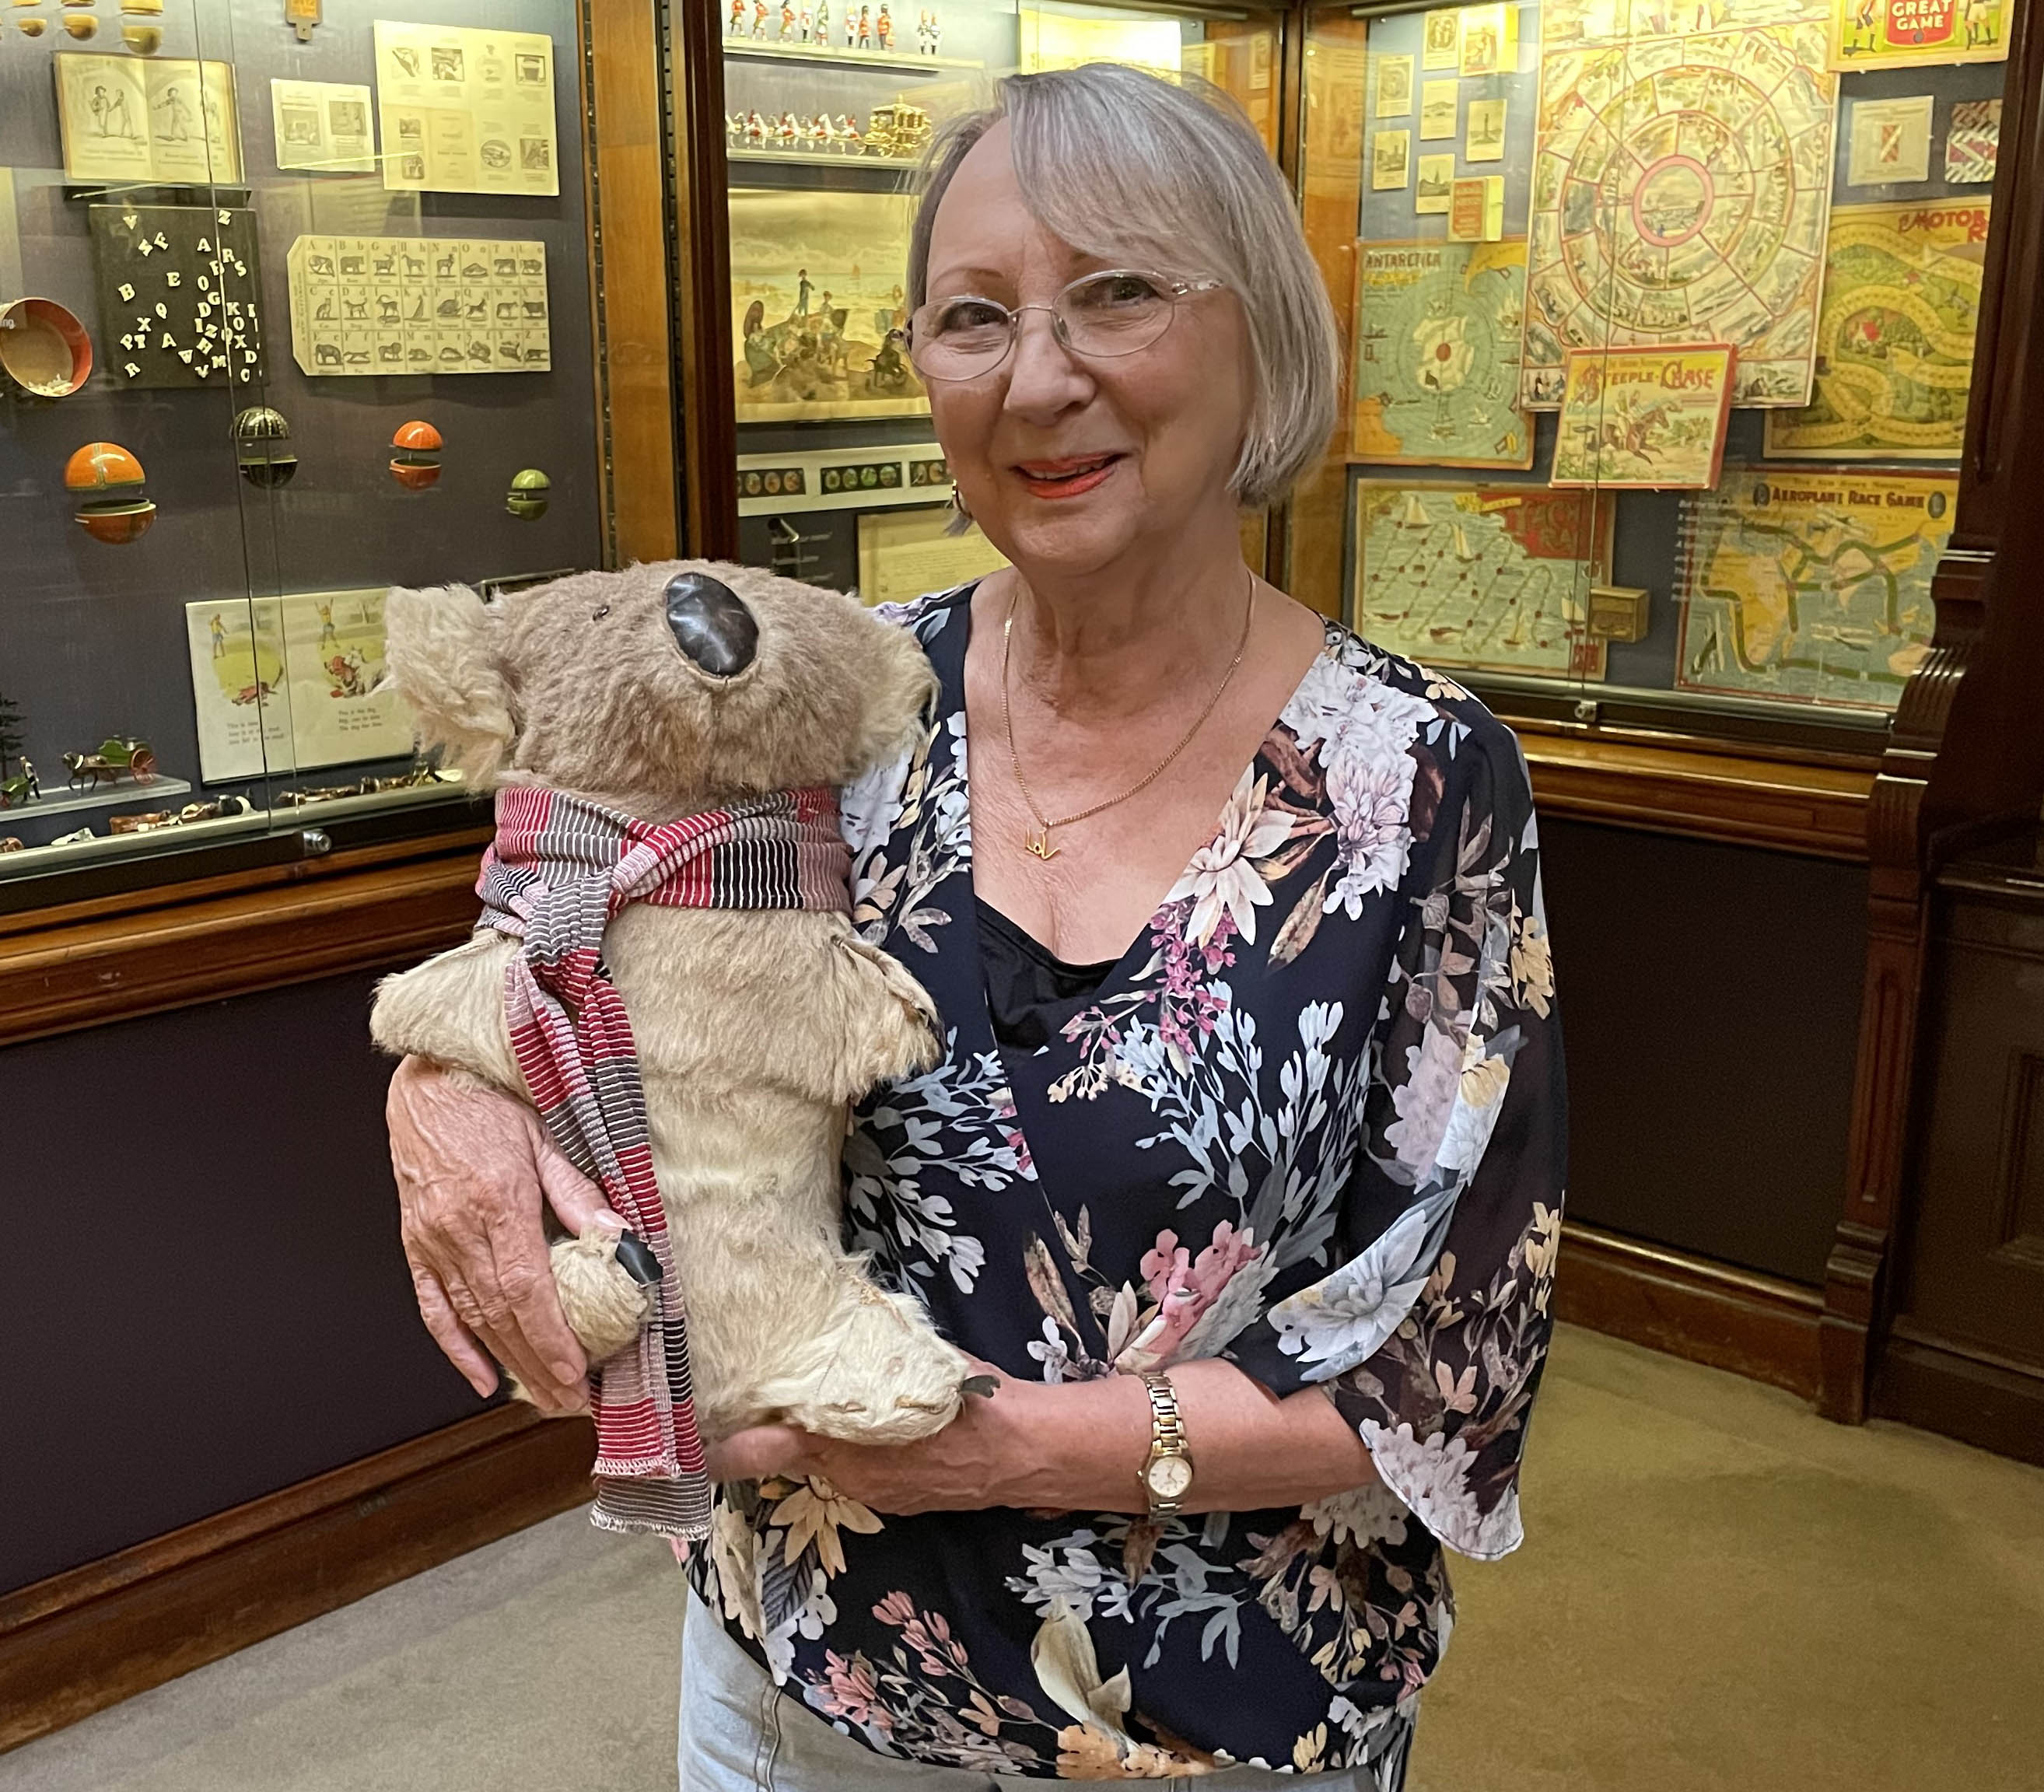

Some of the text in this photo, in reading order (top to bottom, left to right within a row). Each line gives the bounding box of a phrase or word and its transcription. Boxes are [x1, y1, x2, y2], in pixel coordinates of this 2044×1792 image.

[1892, 0, 1952, 17] GREAT
[1896, 14, 1944, 30] GAME
[197, 237, 212, 252] A
[308, 240, 316, 250] A
[339, 240, 346, 250] B
[372, 241, 380, 250] G
[462, 244, 470, 253] O
[222, 248, 235, 263] R
[1365, 252, 1441, 268] ANTARCTICA
[234, 260, 247, 277] S
[166, 272, 180, 286] E
[198, 275, 210, 291] O
[118, 283, 135, 302] B
[207, 291, 221, 305] G
[359, 287, 366, 296] d
[198, 302, 212, 317] D
[226, 302, 241, 316] K
[137, 317, 152, 331] X
[233, 316, 244, 331] O
[162, 333, 177, 348] A
[233, 334, 247, 348] X
[212, 355, 227, 369] M
[244, 350, 257, 363] D
[124, 362, 141, 378] R
[1848, 490, 1881, 506] RACE
[1886, 492, 1925, 509] GAME
